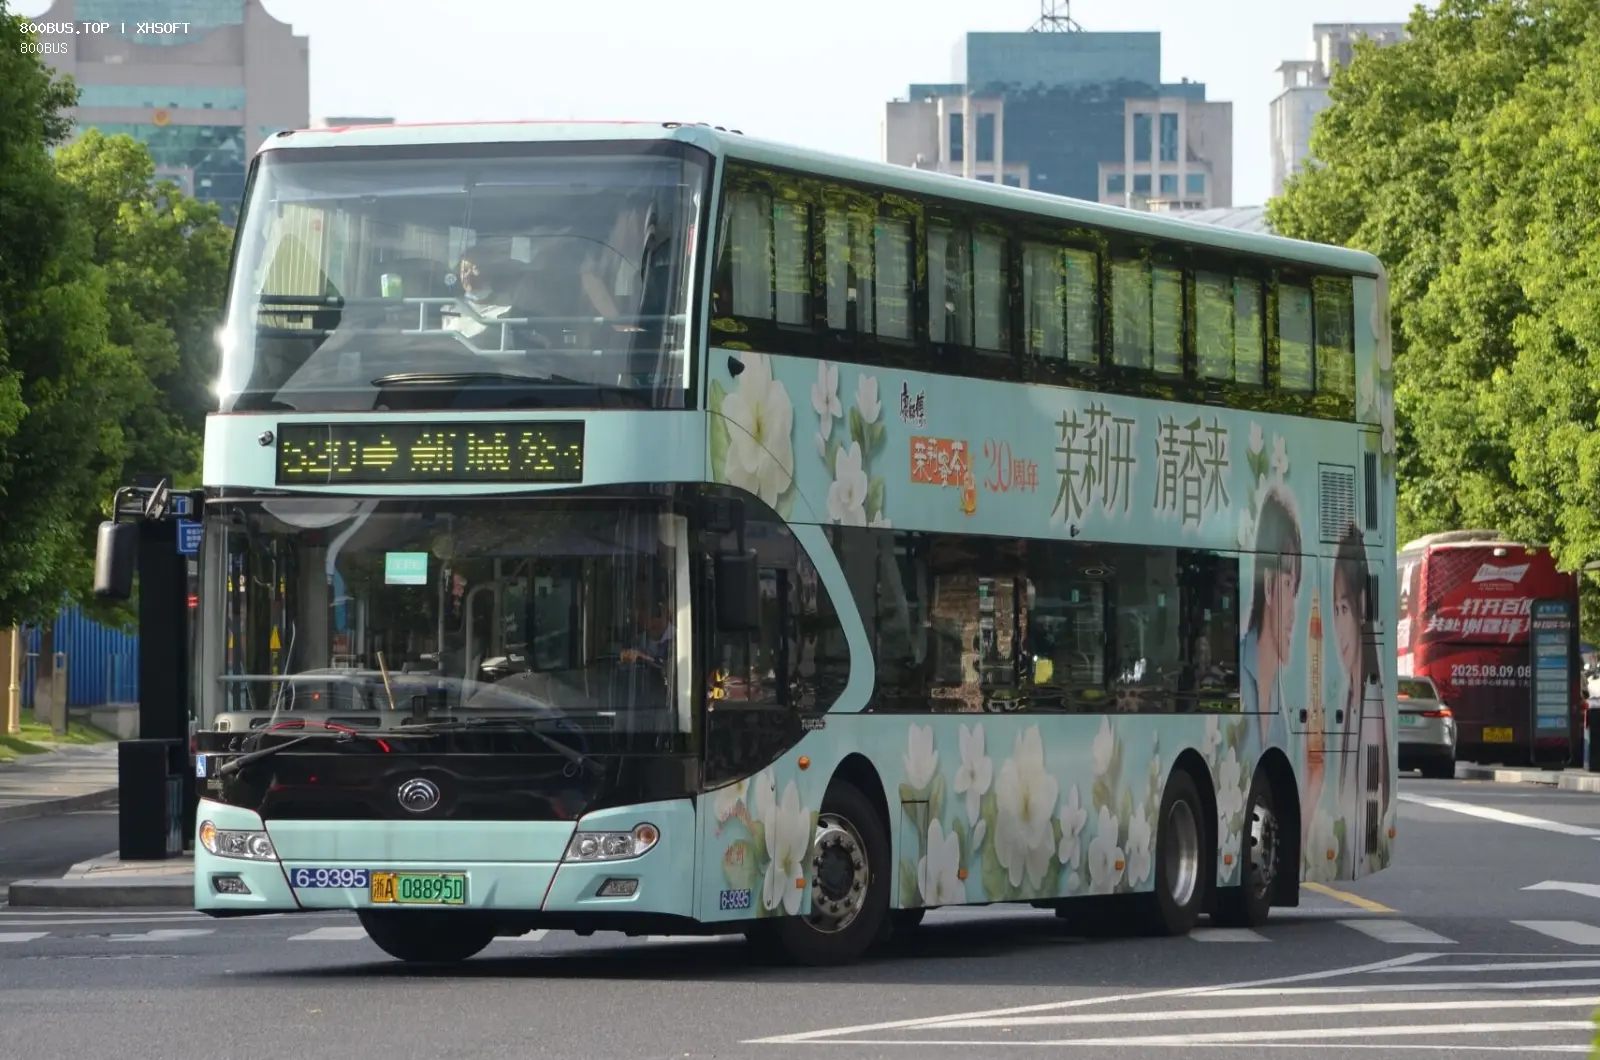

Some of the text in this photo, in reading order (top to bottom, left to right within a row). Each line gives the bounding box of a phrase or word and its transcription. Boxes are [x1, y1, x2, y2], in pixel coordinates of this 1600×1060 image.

[1051, 401, 1229, 527] 茉莉开 清香来
[296, 869, 367, 887] 6-9395
[402, 878, 463, 900] 08895D
[721, 891, 749, 909] 6-9395
